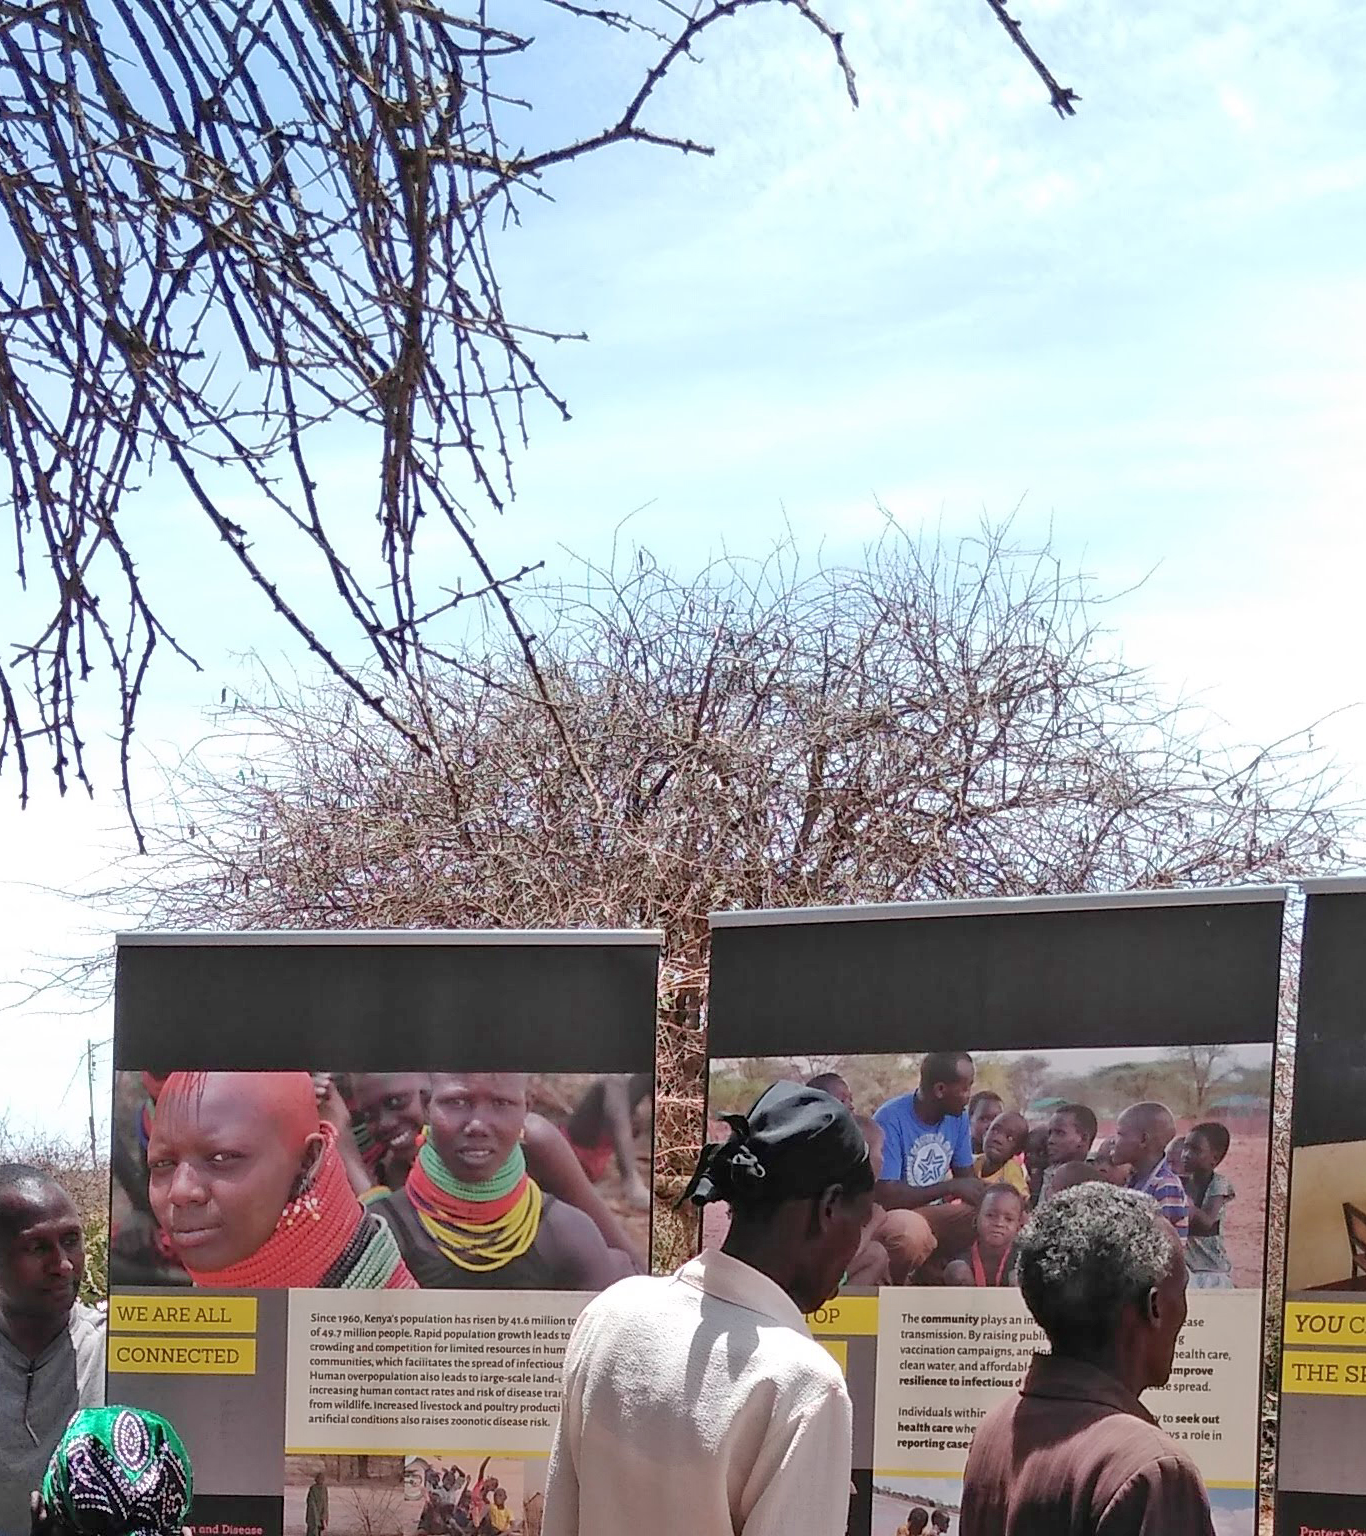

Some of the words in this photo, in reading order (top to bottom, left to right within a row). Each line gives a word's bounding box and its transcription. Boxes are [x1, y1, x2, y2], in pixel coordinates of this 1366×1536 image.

[116, 1306, 147, 1321] WE
[151, 1306, 190, 1322] ARE
[193, 1307, 232, 1322] ALL
[310, 1313, 336, 1322] Since
[337, 1315, 362, 1323] 1960,
[364, 1314, 398, 1324] Kenya's
[399, 1314, 452, 1324] population
[454, 1314, 471, 1324] has
[472, 1315, 496, 1324] risen
[497, 1315, 509, 1326] by
[510, 1316, 529, 1325] 41.6
[531, 1315, 565, 1325] million
[567, 1317, 577, 1325] to
[901, 1313, 919, 1323] The
[920, 1314, 979, 1325] community
[980, 1314, 1007, 1326] plays
[1008, 1316, 1022, 1324] an
[1295, 1314, 1345, 1333] YOU
[117, 1347, 239, 1364] CONNECTED
[1291, 1363, 1338, 1382] THE
[198, 1524, 218, 1533] and
[221, 1524, 263, 1534] Disease
